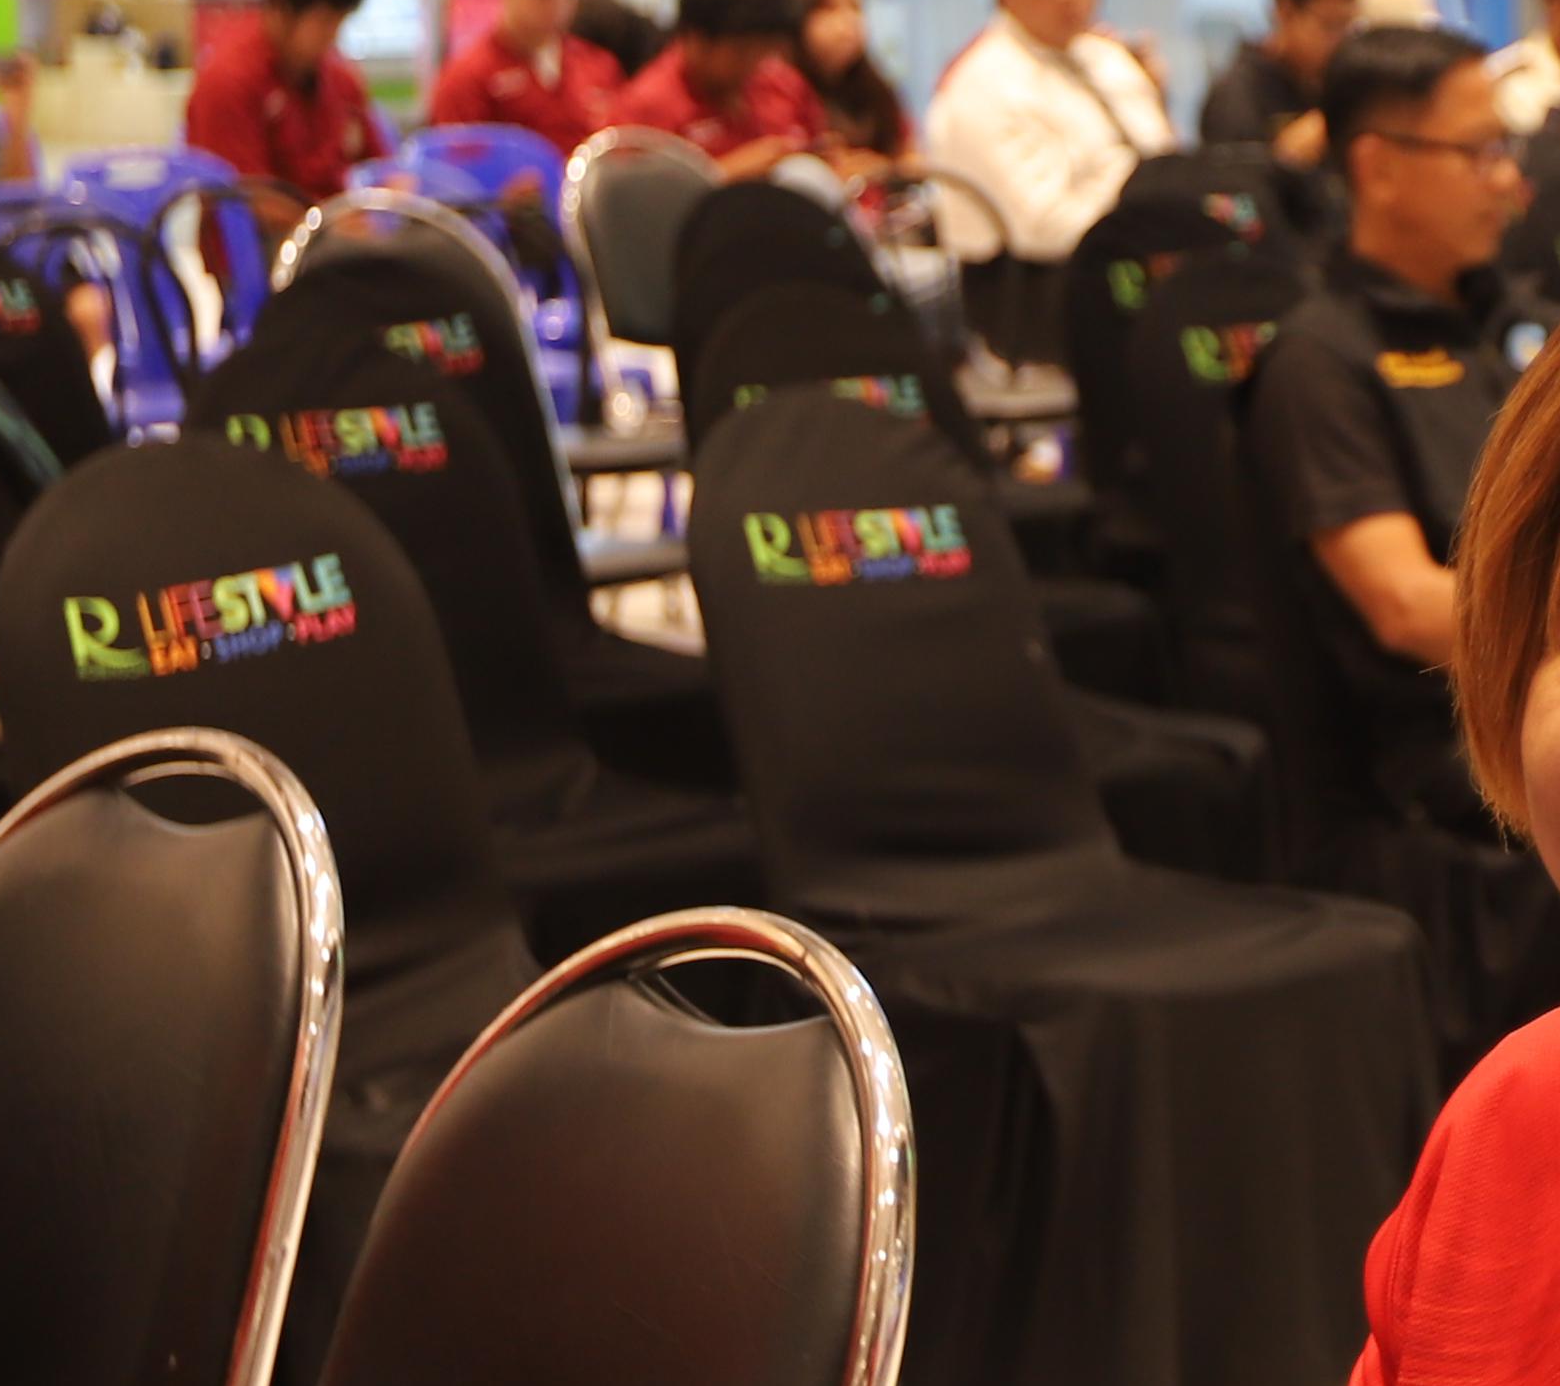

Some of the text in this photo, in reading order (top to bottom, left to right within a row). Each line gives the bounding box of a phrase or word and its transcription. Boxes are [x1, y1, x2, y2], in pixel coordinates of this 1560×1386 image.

[796, 504, 967, 561] LIFESTYLE
[65, 554, 352, 669] R LIFESTYLE
